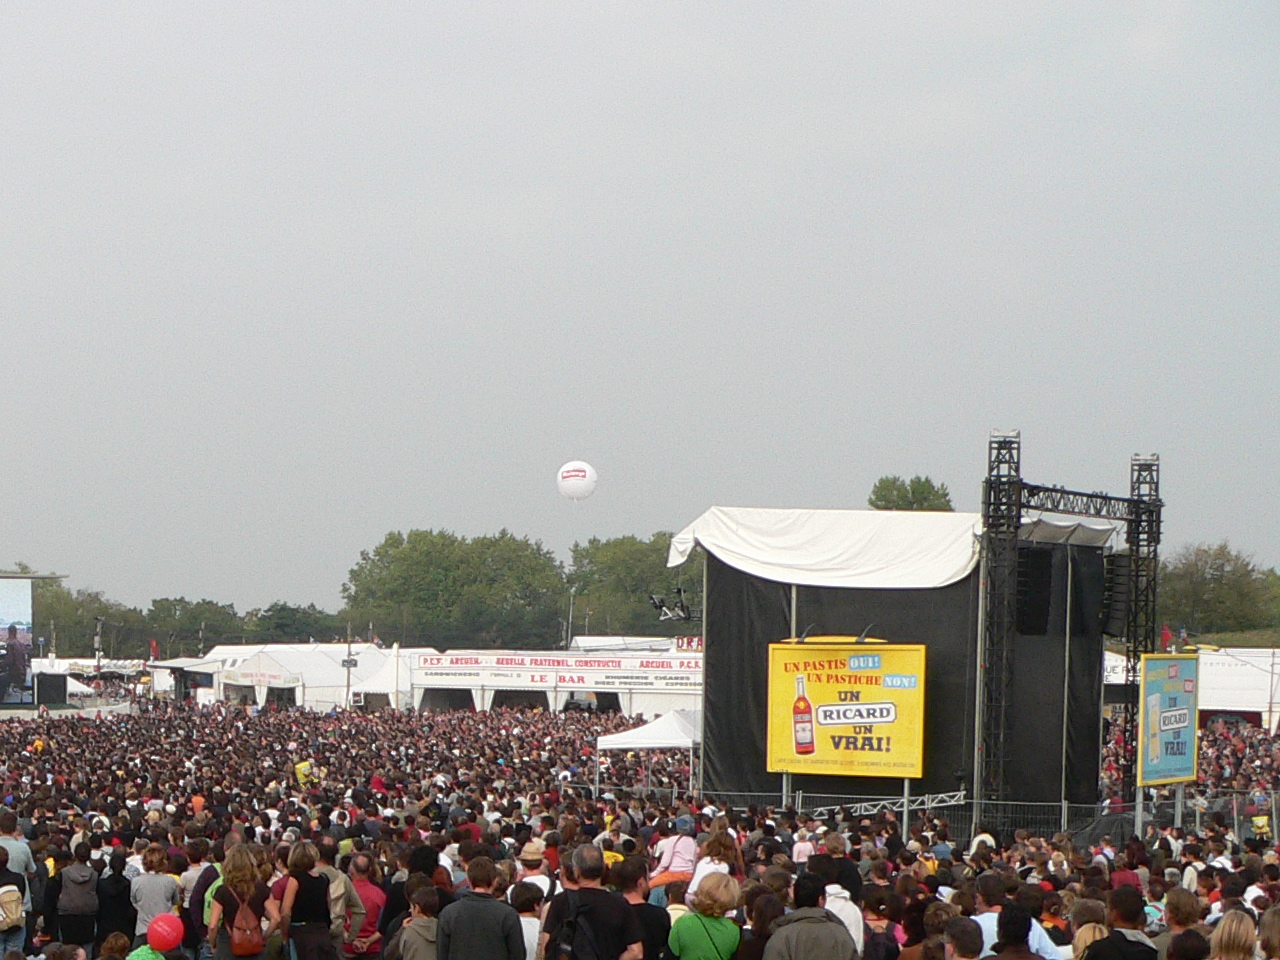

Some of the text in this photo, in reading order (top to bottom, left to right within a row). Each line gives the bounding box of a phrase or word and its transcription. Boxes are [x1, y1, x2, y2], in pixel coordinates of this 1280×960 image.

[784, 656, 880, 673] UN PASTIS OUI!
[529, 674, 549, 683] LE
[558, 675, 586, 684] BAR
[807, 673, 916, 688] UN PASTICHE NON!
[837, 691, 861, 702] UN
[822, 707, 892, 721] RICARD
[853, 725, 873, 735] UN
[830, 735, 891, 753] VRAI!
